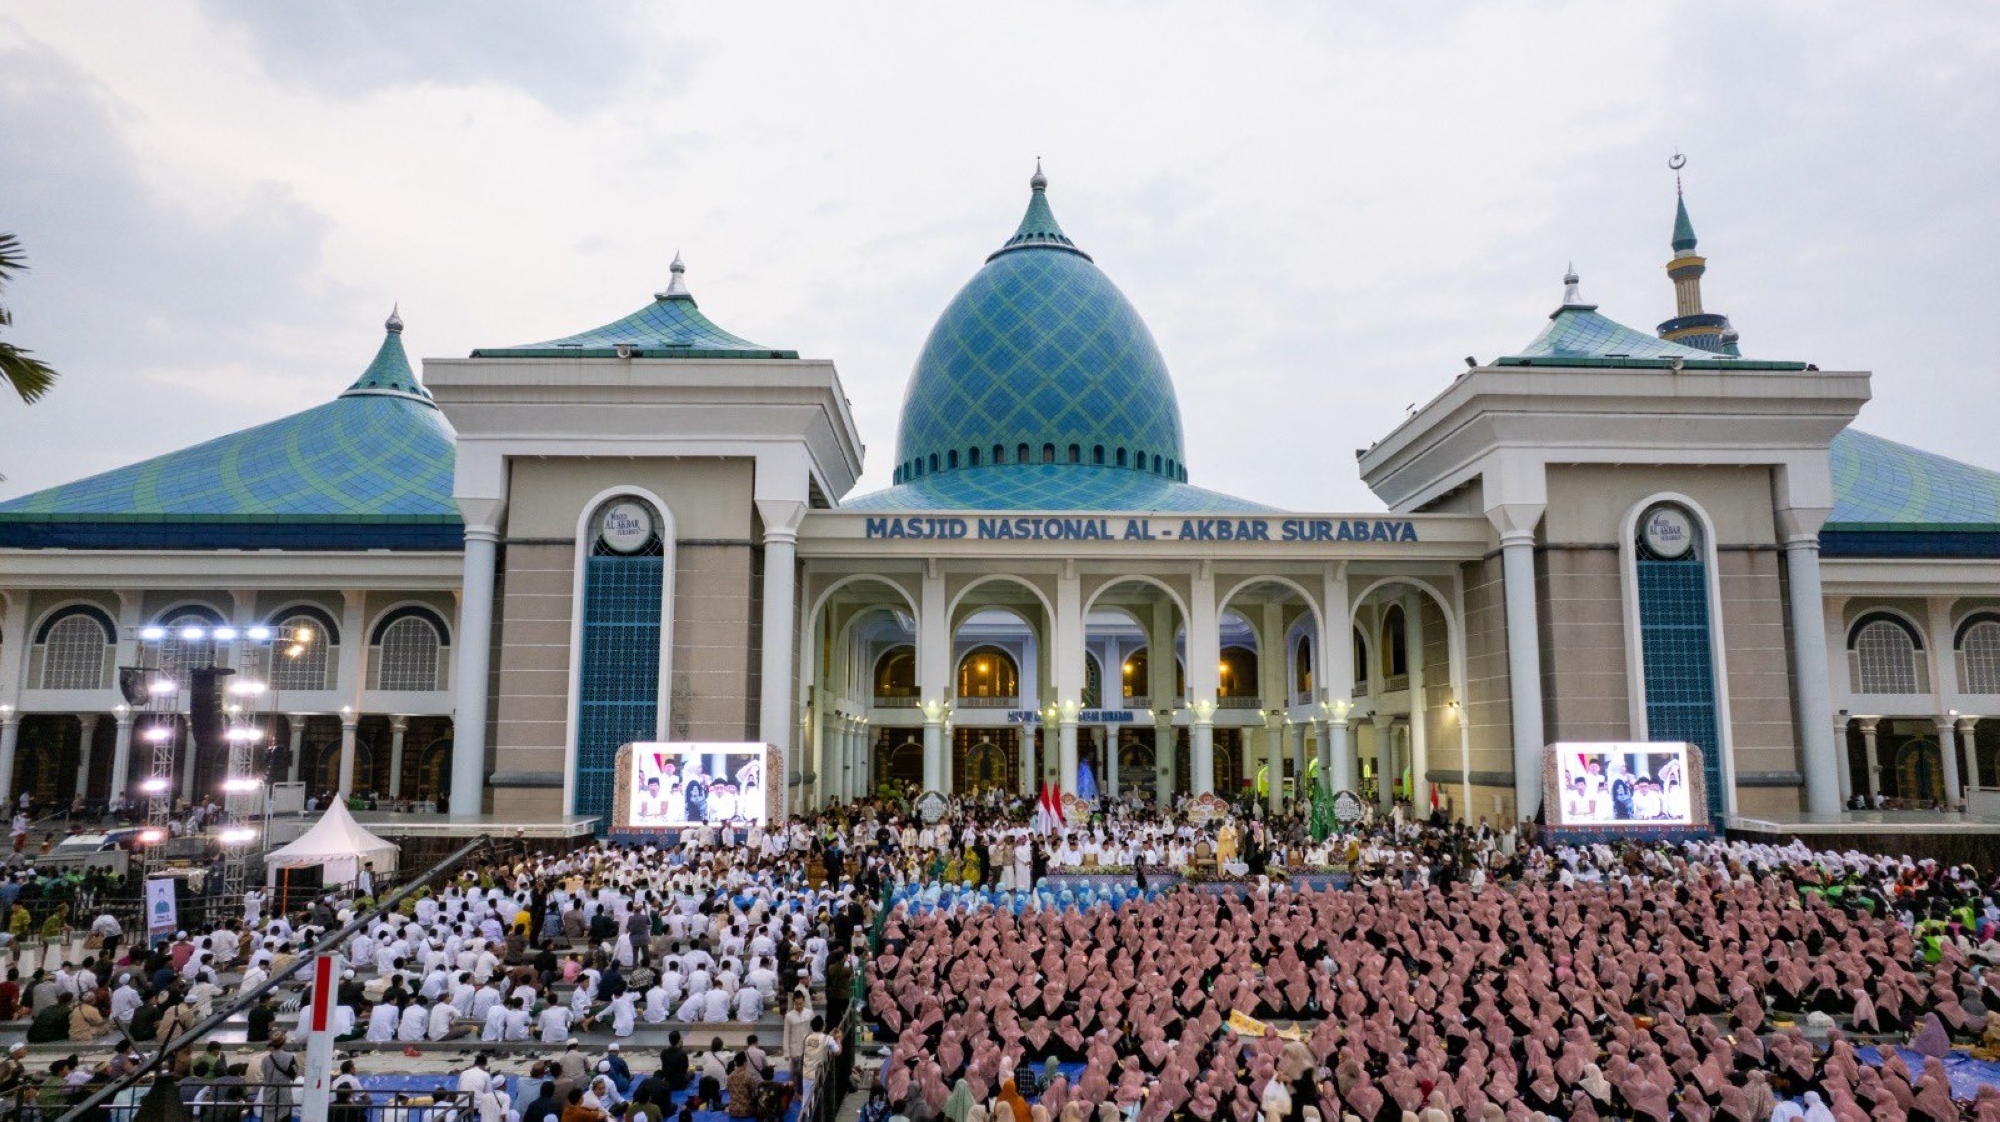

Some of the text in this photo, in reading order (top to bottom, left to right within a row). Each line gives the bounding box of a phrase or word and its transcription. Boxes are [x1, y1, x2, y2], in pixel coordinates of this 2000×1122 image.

[865, 517, 968, 540] MASJID
[977, 518, 1115, 541] NASIONAL
[1123, 519, 1156, 540] AL
[1178, 519, 1270, 541] AKBAR
[1281, 520, 1418, 542] SURABAYA
